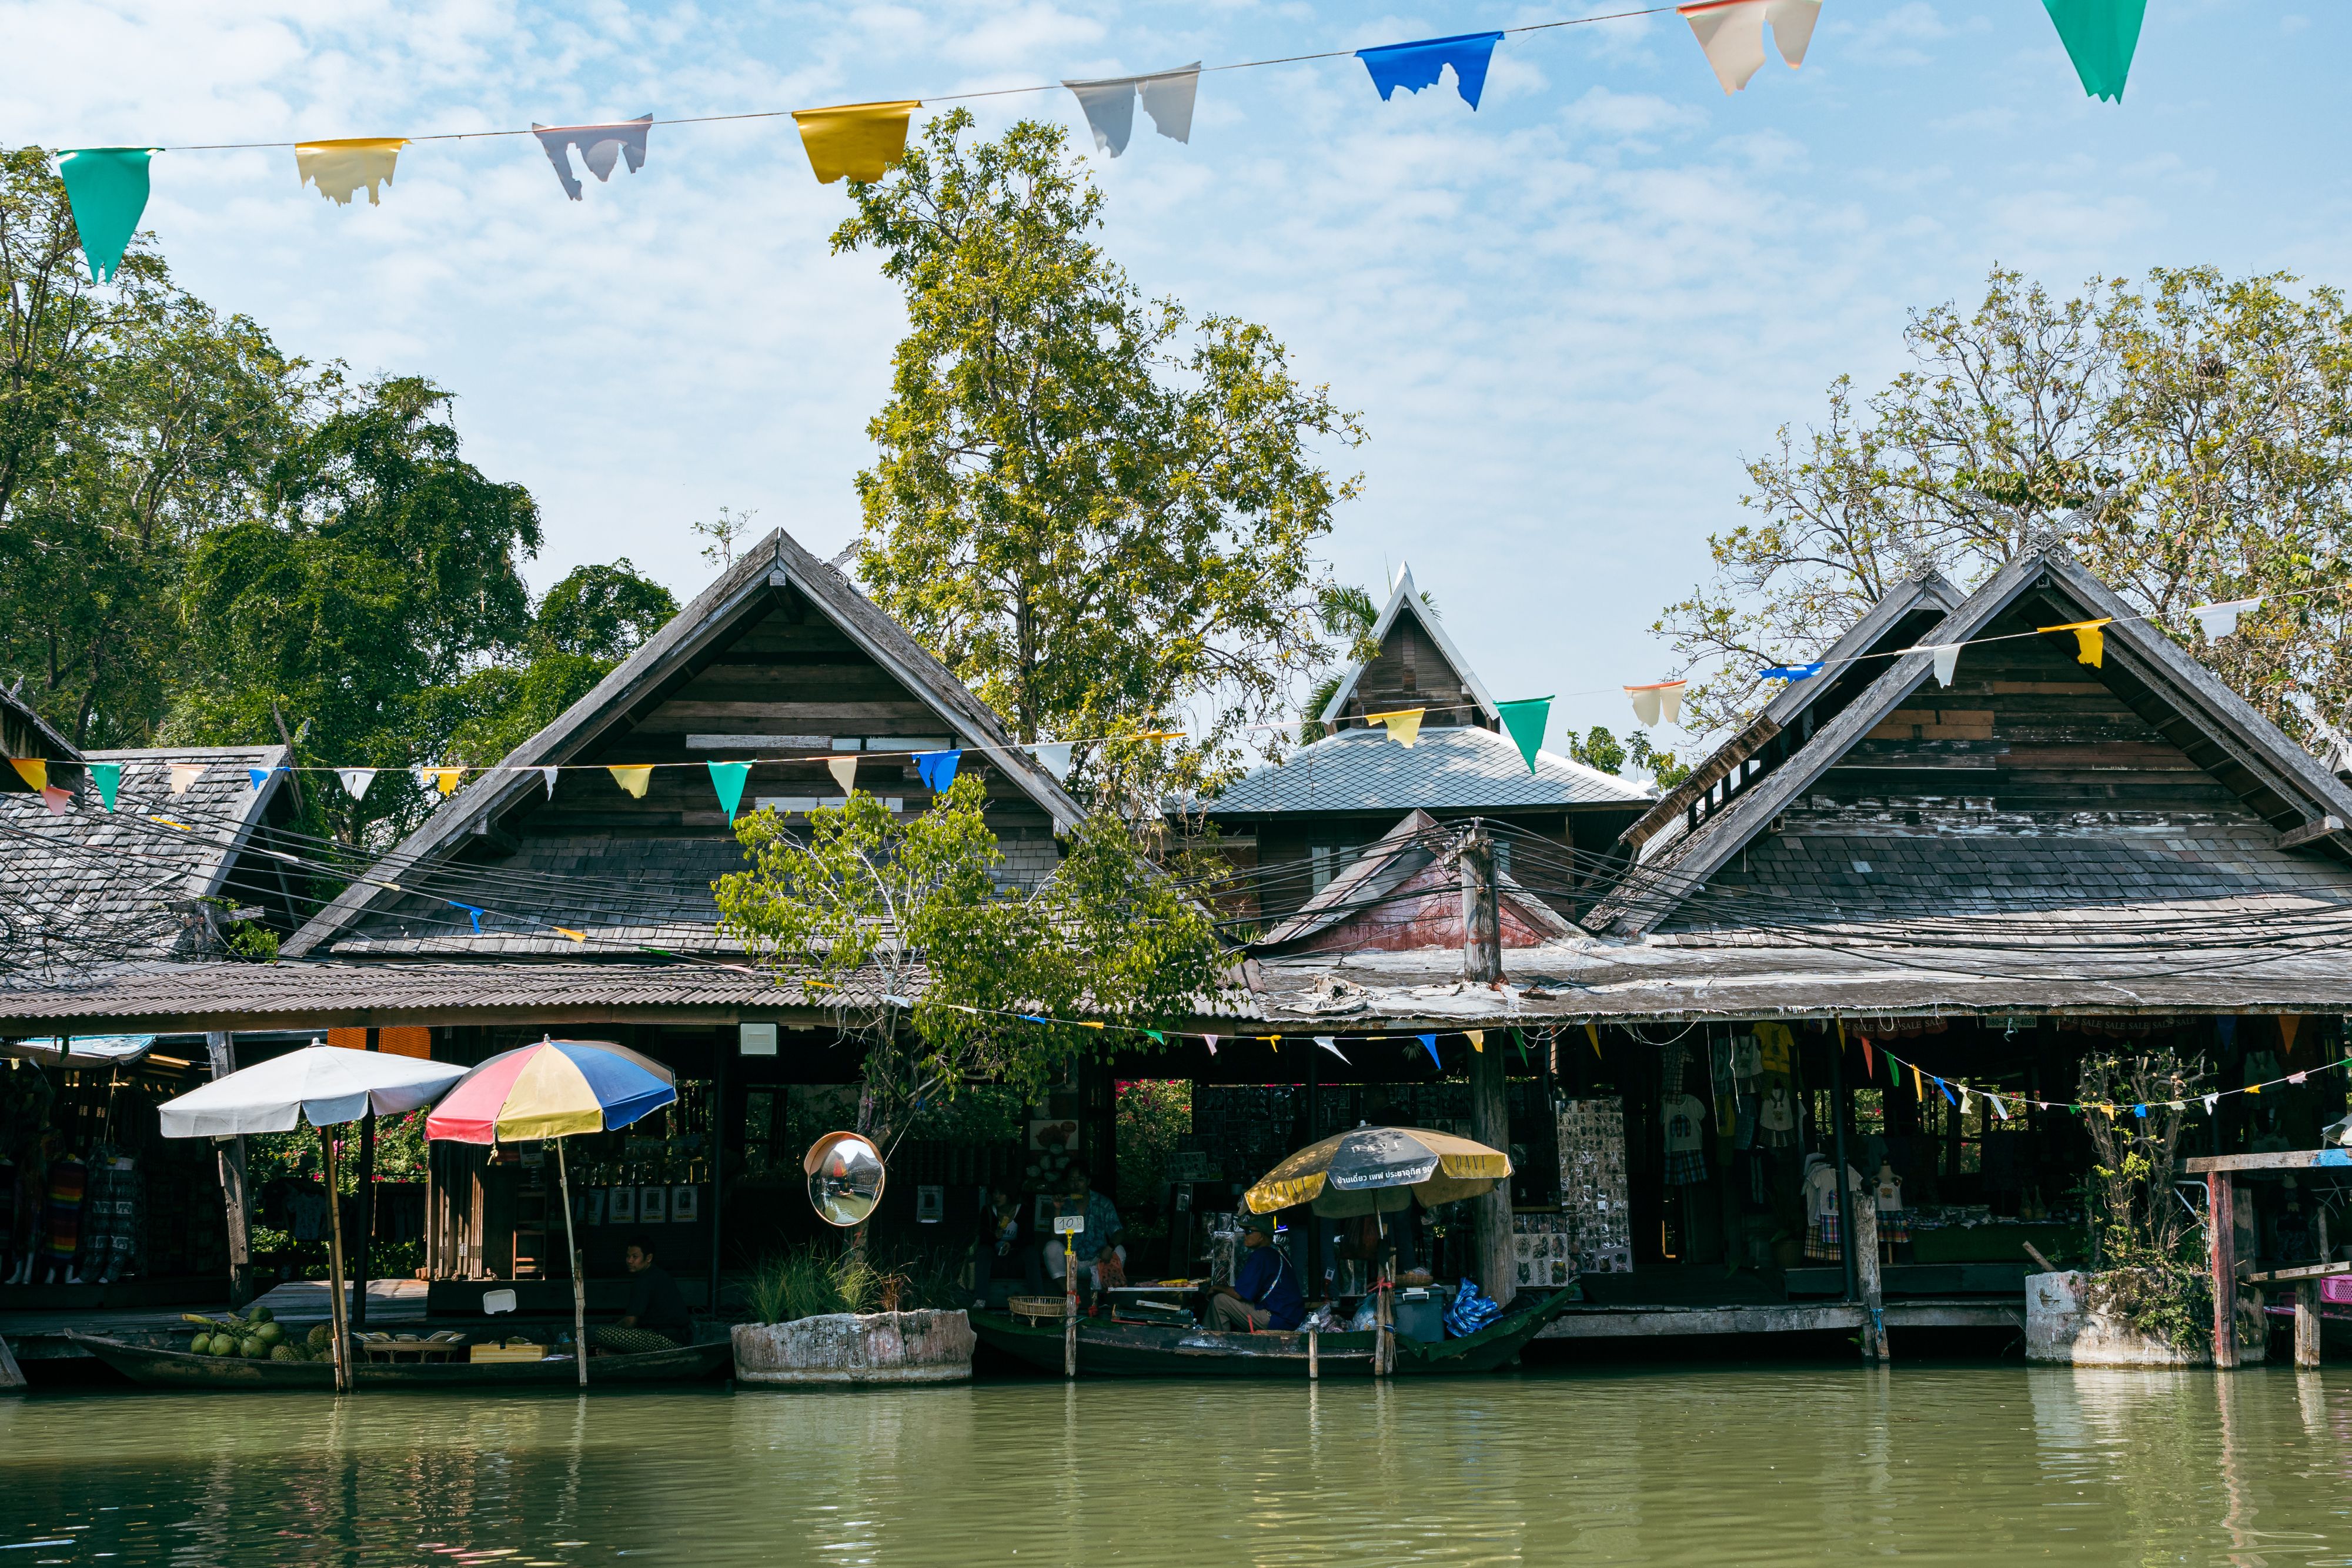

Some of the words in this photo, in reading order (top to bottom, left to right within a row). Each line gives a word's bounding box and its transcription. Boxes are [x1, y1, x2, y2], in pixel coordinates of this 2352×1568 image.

[1853, 1023, 1874, 1032] SALE
[1901, 1021, 1922, 1031] SALE
[1925, 1017, 1946, 1027] SALE
[2080, 1017, 2103, 1028] SALE
[2105, 1021, 2125, 1029] SALE
[2128, 1021, 2149, 1029] SALE
[2176, 1016, 2197, 1027] SALE
[1351, 1141, 1402, 1154] PAVE
[1337, 1172, 1367, 1184] บ้านเดี่ยว
[1385, 1167, 1421, 1178] ประชาอุทิศ
